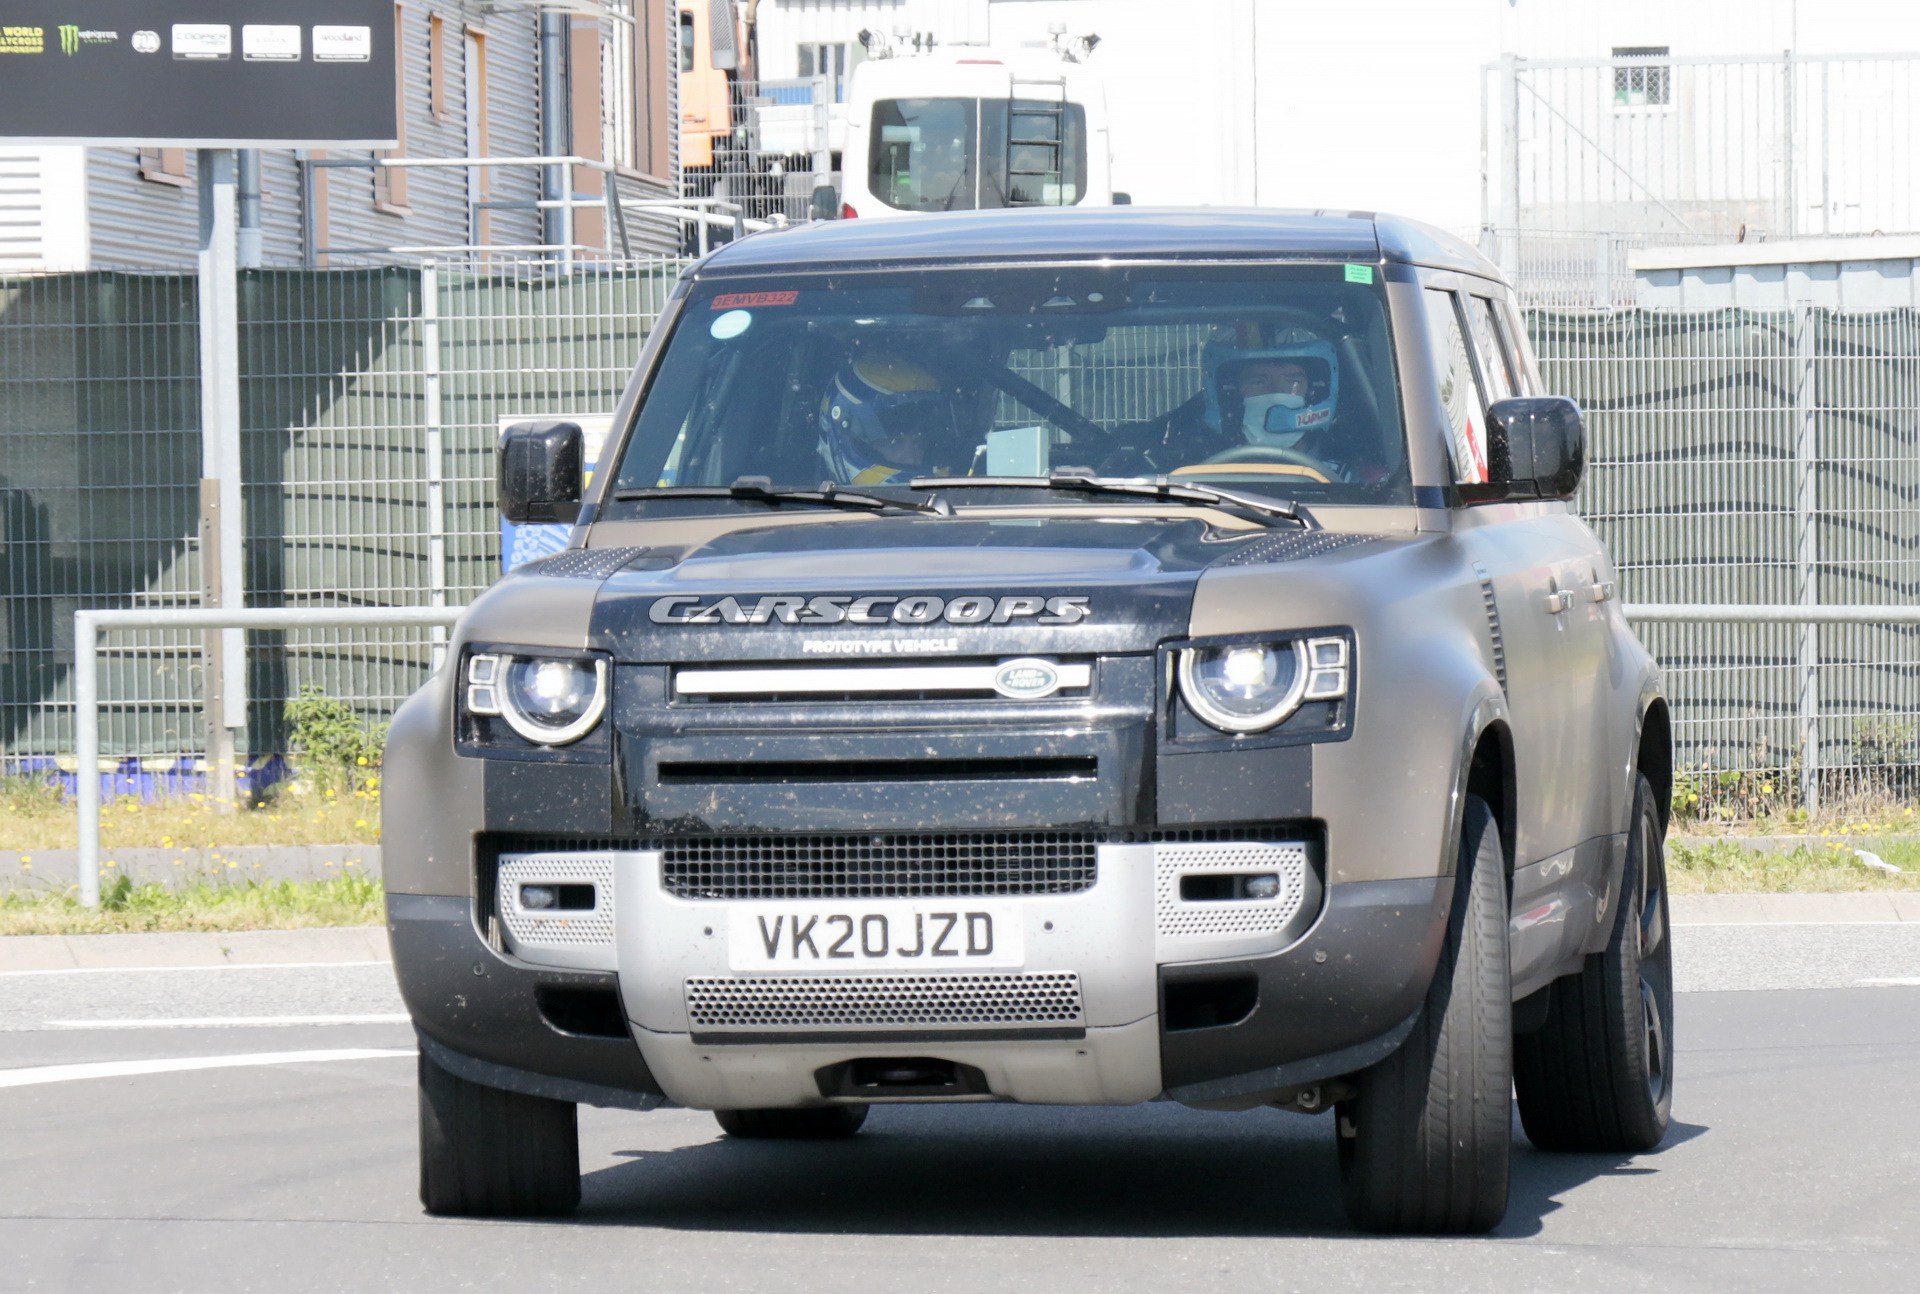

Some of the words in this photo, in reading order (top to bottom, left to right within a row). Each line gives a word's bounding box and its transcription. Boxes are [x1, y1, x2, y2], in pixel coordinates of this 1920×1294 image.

[2, 26, 43, 37] WORLD
[175, 32, 227, 40] COOPER
[803, 638, 892, 654] PROTOTYPE
[893, 638, 958, 653] VEHICLE
[1008, 669, 1037, 679] LAND
[1011, 677, 1046, 688] ROVER
